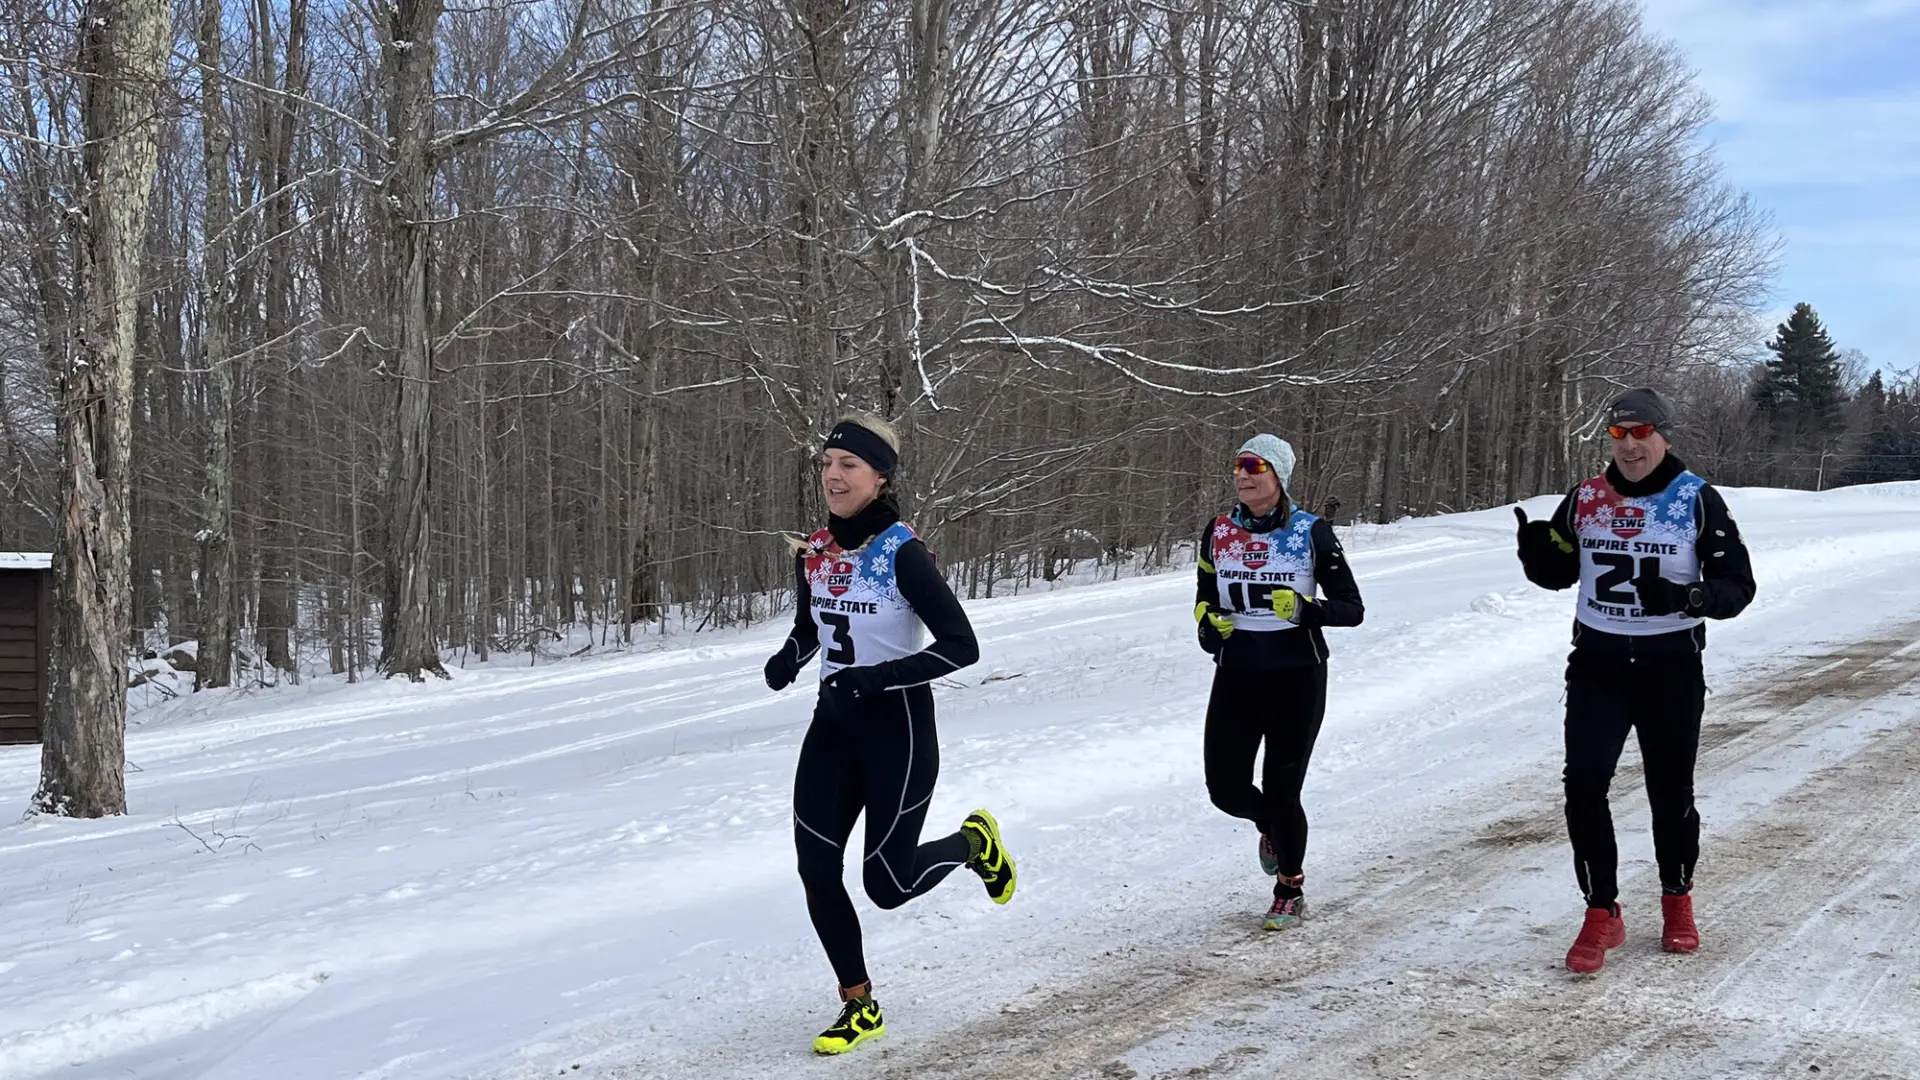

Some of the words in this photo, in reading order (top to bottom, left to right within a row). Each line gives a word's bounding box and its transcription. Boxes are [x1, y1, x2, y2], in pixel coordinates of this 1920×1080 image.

[1611, 517, 1645, 528] ESWG
[1582, 537, 1628, 552] EMPIRE
[1633, 542, 1677, 555] STATE
[1242, 551, 1269, 561] ESWG
[828, 574, 852, 585] ESWG
[1219, 569, 1256, 581] EMPIRE
[1260, 572, 1295, 582] STATE
[810, 595, 838, 610] MPIRE
[839, 600, 877, 614] STATE
[819, 611, 855, 665] 3
